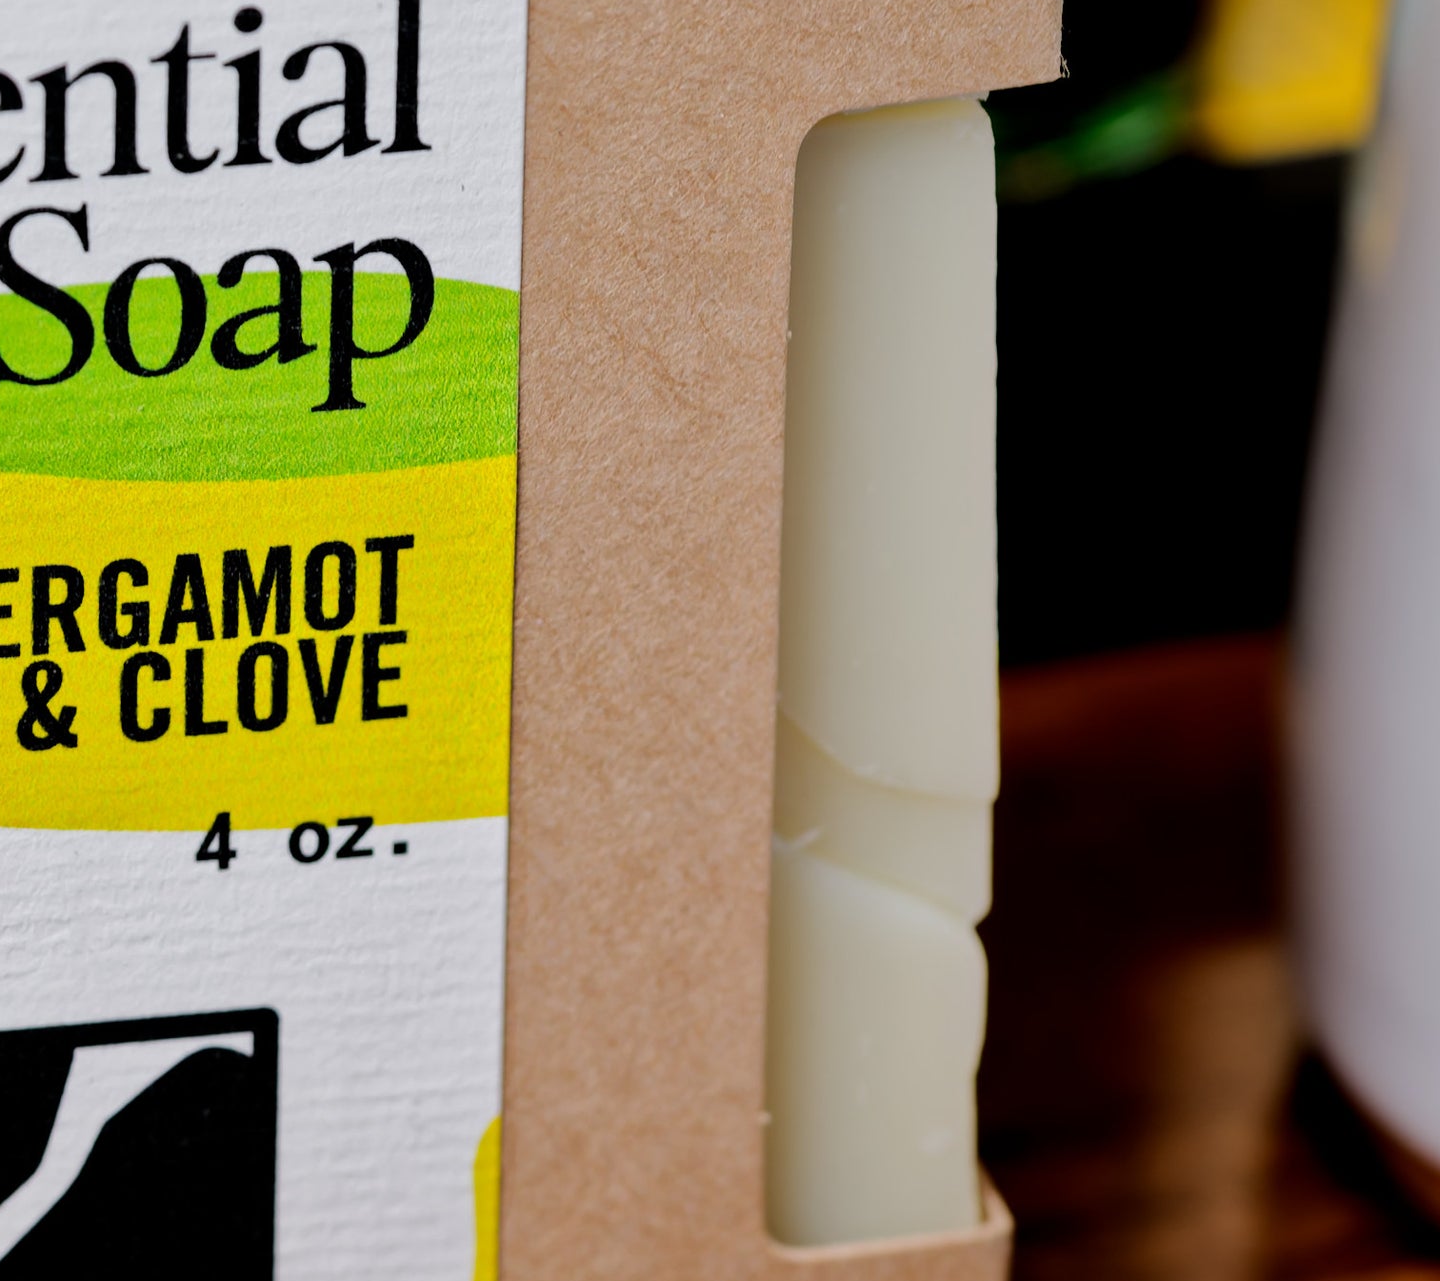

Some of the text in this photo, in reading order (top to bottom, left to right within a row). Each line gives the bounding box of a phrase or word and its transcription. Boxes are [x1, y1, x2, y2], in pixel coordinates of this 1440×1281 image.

[14, 629, 410, 753] & CLOVE
[194, 810, 410, 872] 4 oz.
